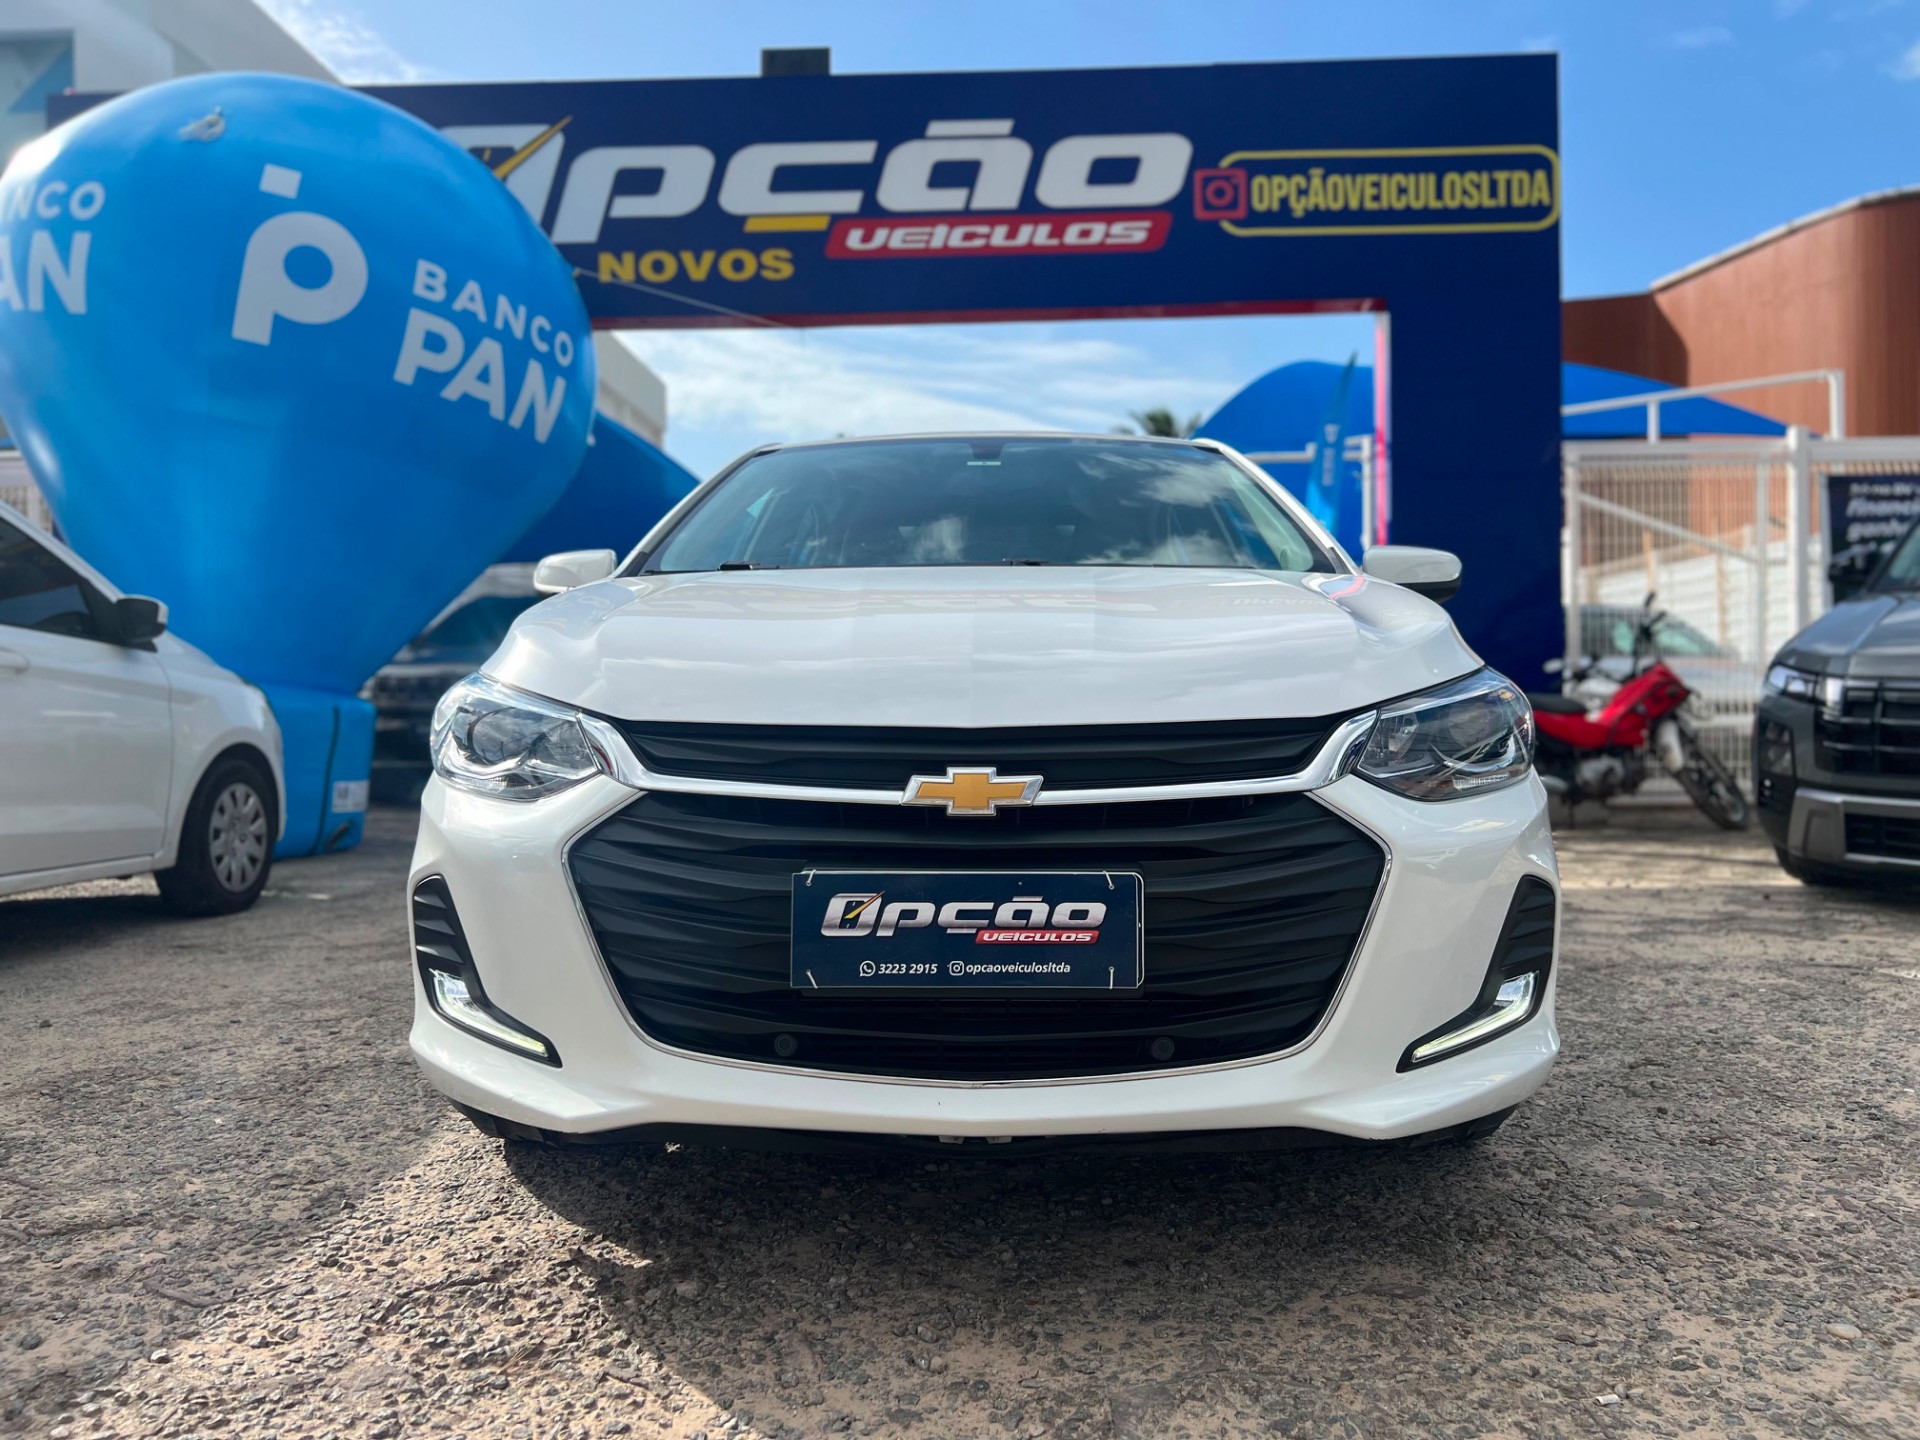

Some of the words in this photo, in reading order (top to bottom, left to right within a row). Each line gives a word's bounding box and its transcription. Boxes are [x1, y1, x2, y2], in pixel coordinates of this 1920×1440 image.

[0, 180, 107, 222] NCO
[1251, 167, 1551, 218] OPÇÃOVEICULOSLTDA
[0, 229, 93, 316] AN
[599, 248, 795, 283] NOVOS
[412, 258, 574, 368] BANCO
[393, 306, 567, 445] PAN
[878, 963, 907, 975] 3223
[909, 963, 938, 975] 2915
[966, 962, 1071, 976] opcaoveiculosltda
